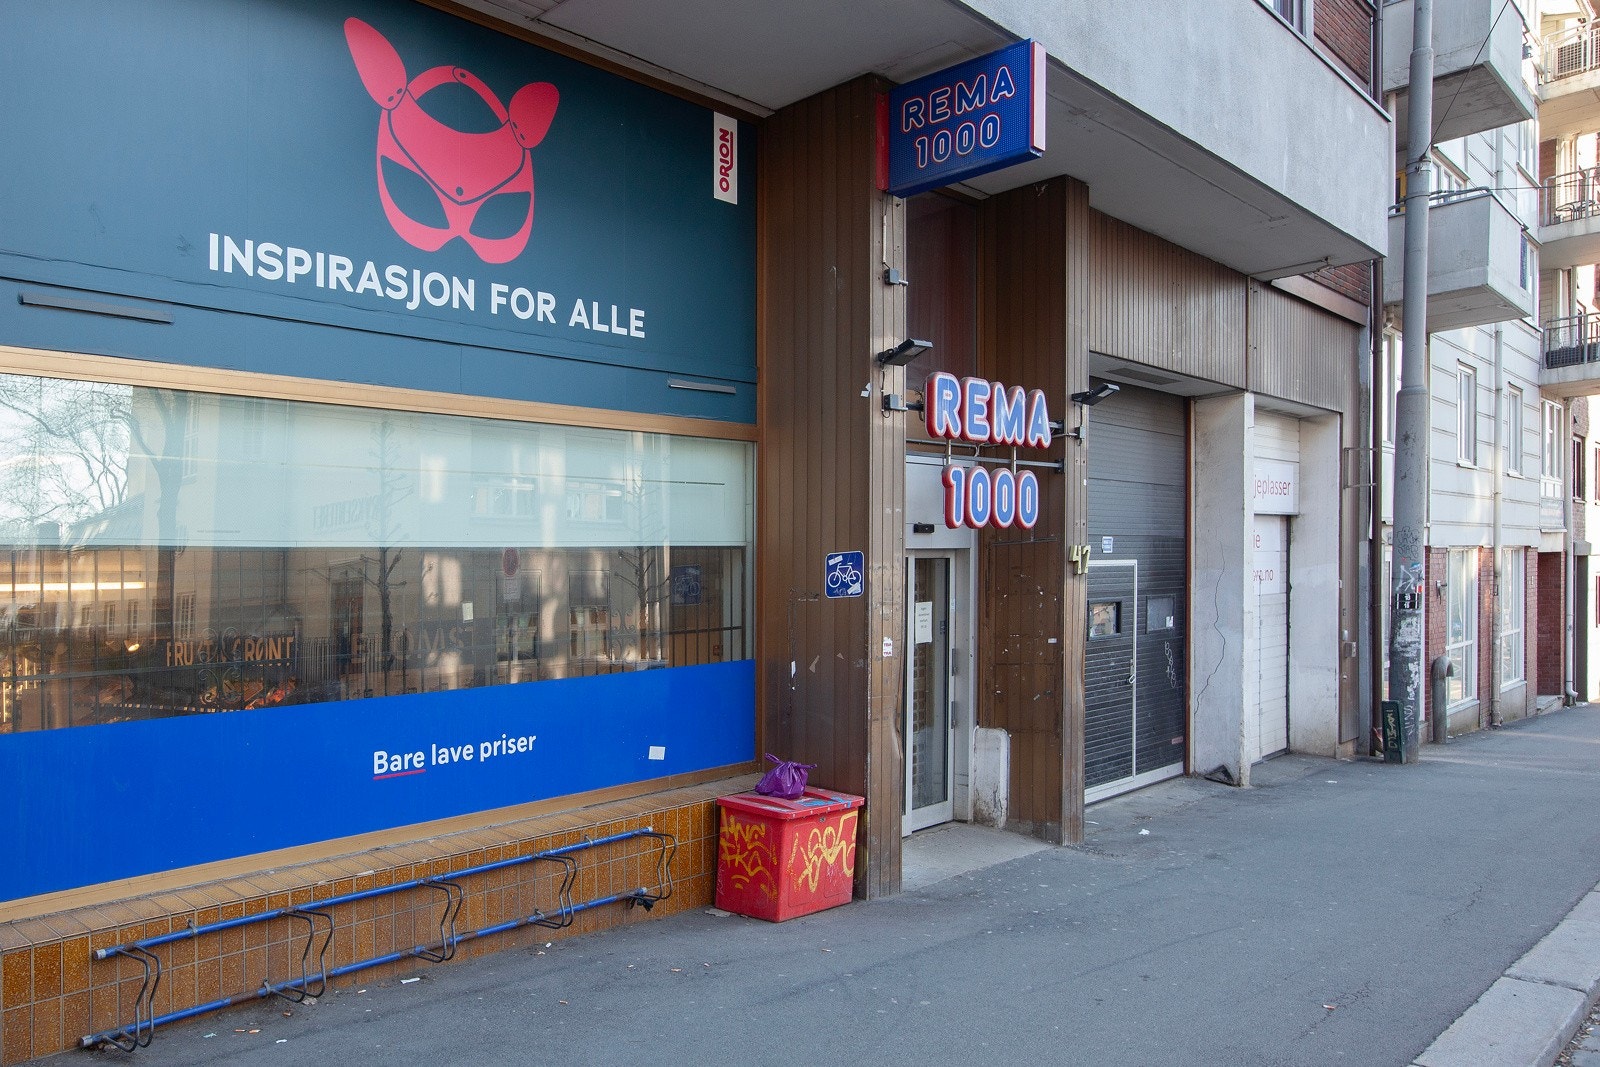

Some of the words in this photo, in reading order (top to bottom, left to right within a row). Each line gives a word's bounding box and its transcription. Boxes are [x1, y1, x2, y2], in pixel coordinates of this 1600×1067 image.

[902, 65, 1015, 133] REMA
[719, 127, 733, 193] ORION
[915, 113, 1001, 168] 1000
[209, 232, 475, 311] INSPIRASJON
[491, 282, 556, 324] FOR
[568, 298, 645, 339] ALLE
[926, 371, 1051, 449] REMA
[941, 465, 1039, 530] 1000
[1069, 544, 1091, 575] 47
[373, 750, 426, 776] Bare
[431, 743, 474, 766] lave
[479, 733, 537, 763] priser
